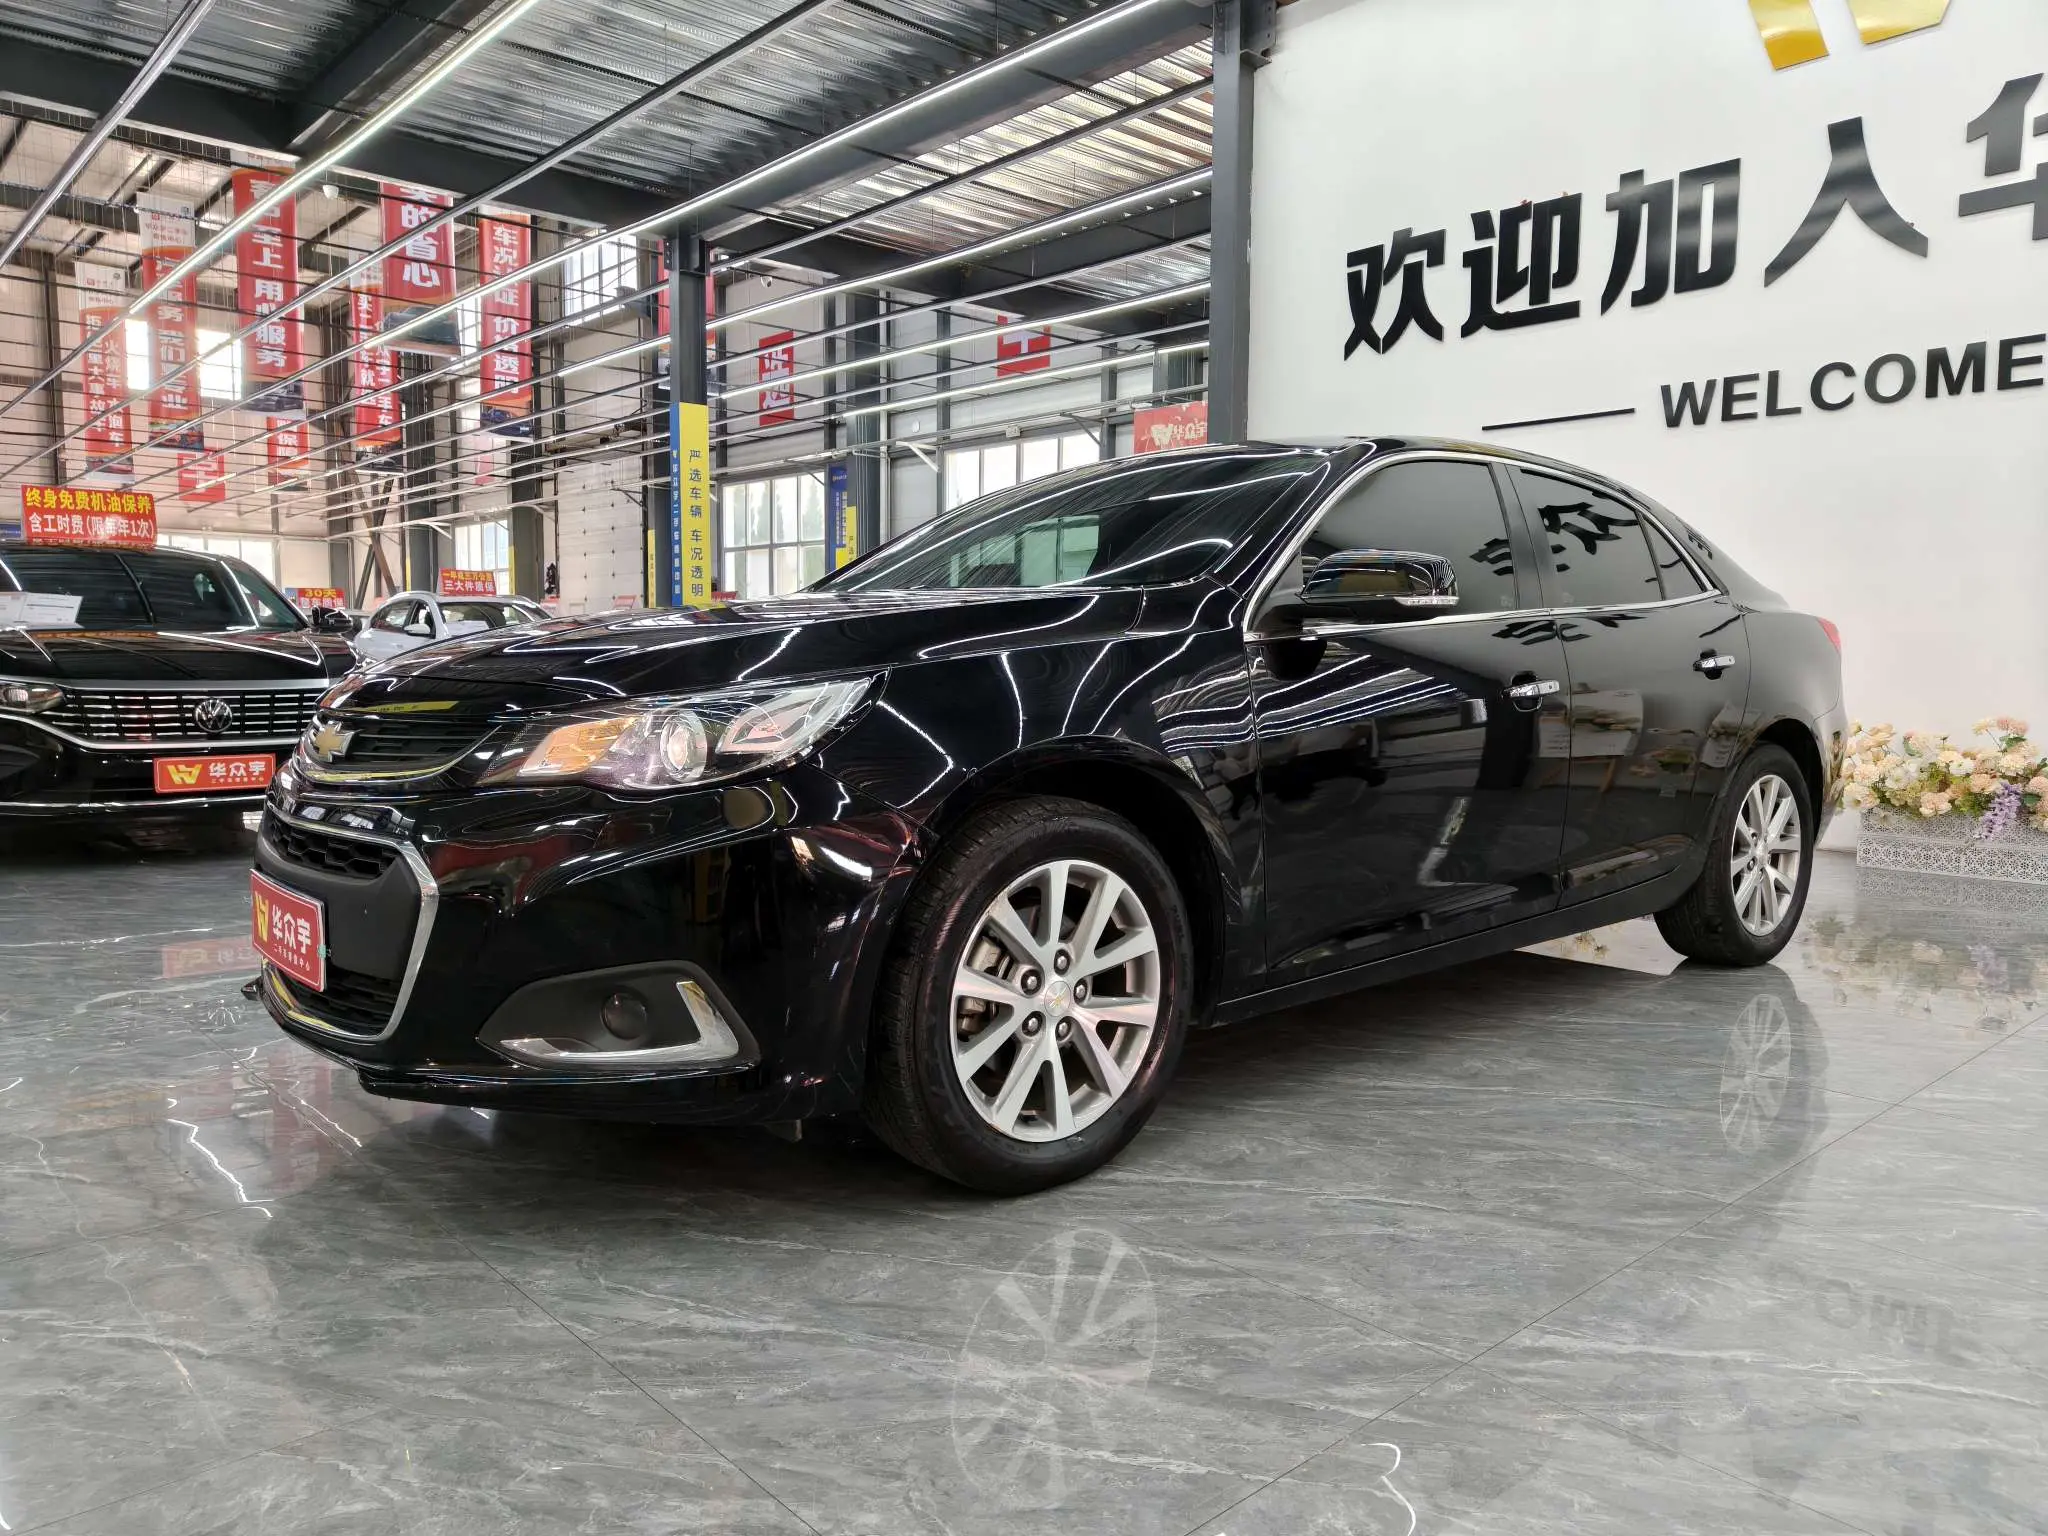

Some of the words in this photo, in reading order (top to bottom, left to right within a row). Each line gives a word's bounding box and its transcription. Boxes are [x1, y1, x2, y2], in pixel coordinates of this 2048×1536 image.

[1661, 332, 2047, 428] WELCOME
[26, 487, 152, 514] 终身免费机油保养
[689, 449, 703, 518] 严选车辆
[690, 529, 704, 597] 车况透明
[209, 761, 266, 776] 华众宇
[272, 904, 312, 954] 华众宇
